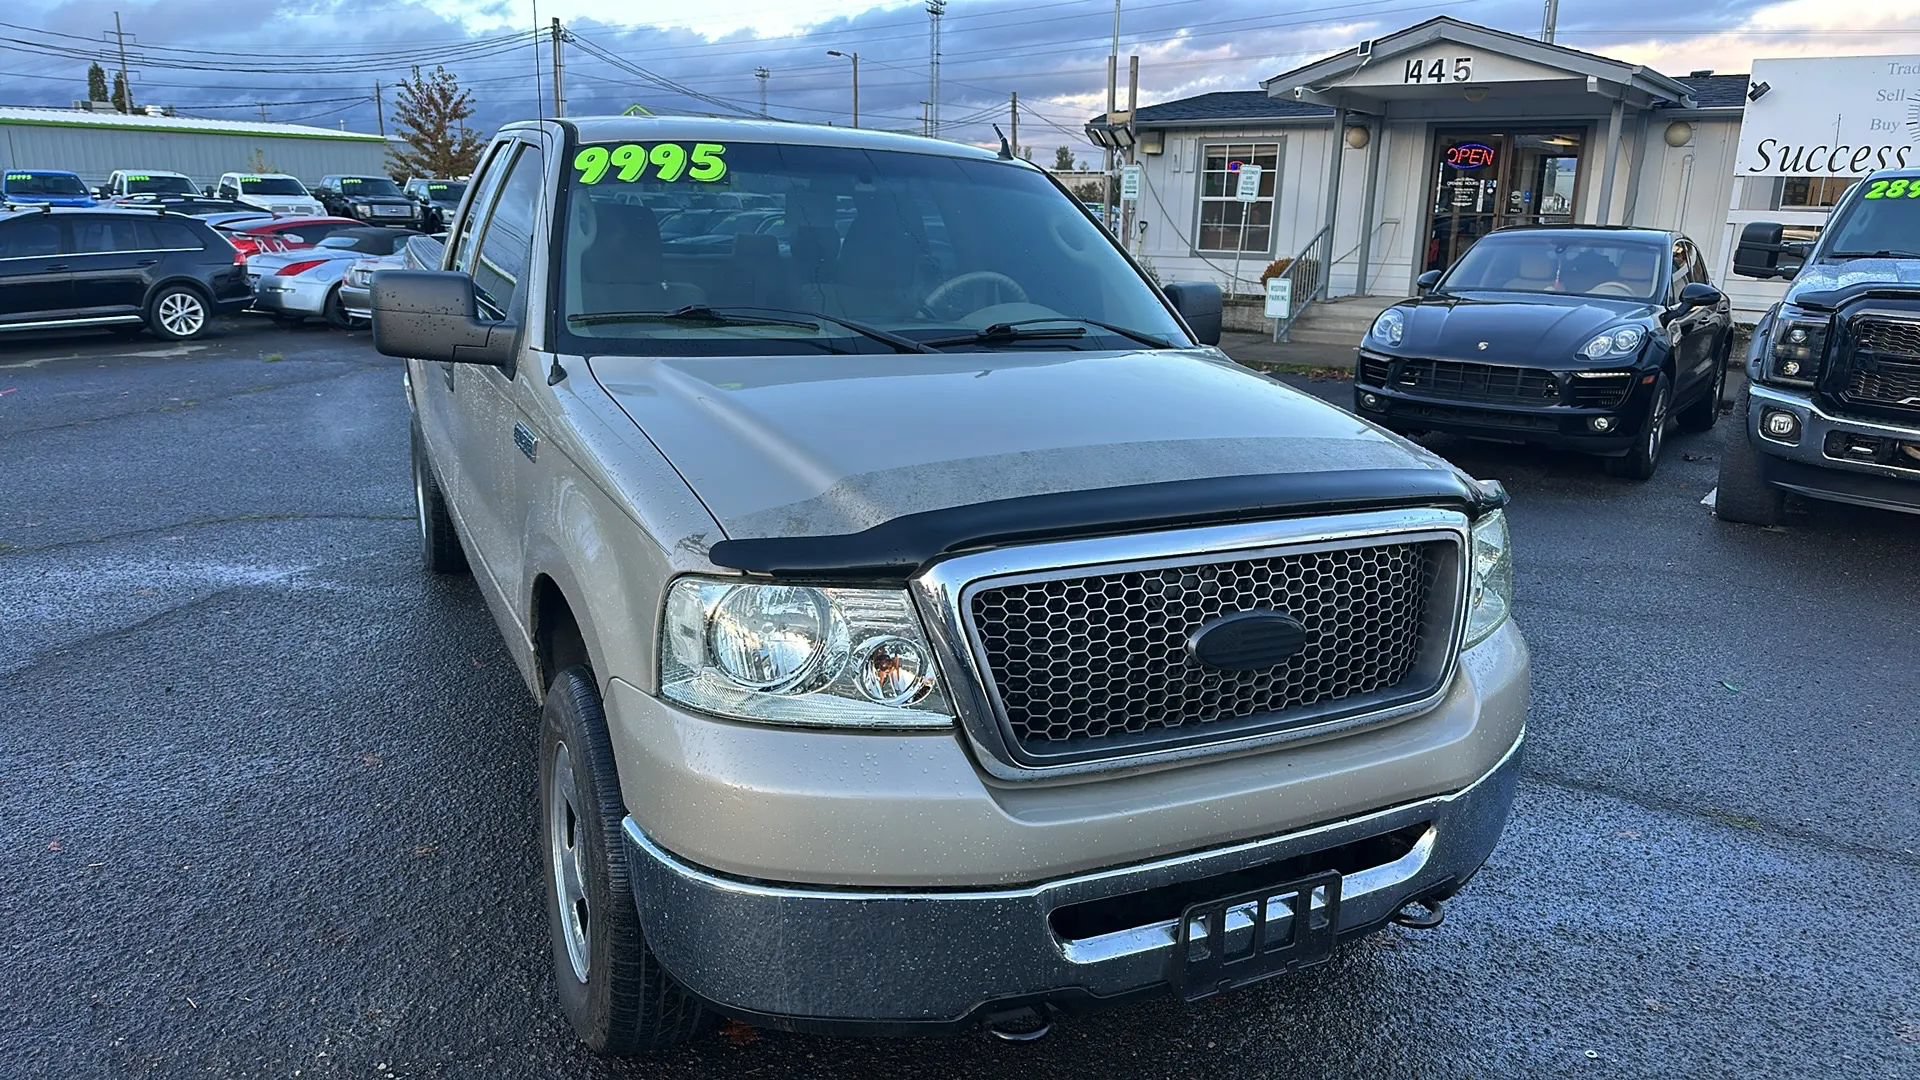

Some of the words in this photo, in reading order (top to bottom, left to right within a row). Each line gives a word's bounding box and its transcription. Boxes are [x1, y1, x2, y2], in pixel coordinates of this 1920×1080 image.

[1404, 57, 1472, 83] 1445
[1877, 88, 1905, 102] Sell
[1870, 118, 1901, 134] Buy
[574, 143, 727, 185] 9995
[1447, 147, 1494, 166] OPEN
[1748, 138, 1912, 172] Success
[1864, 178, 1920, 199] 289
